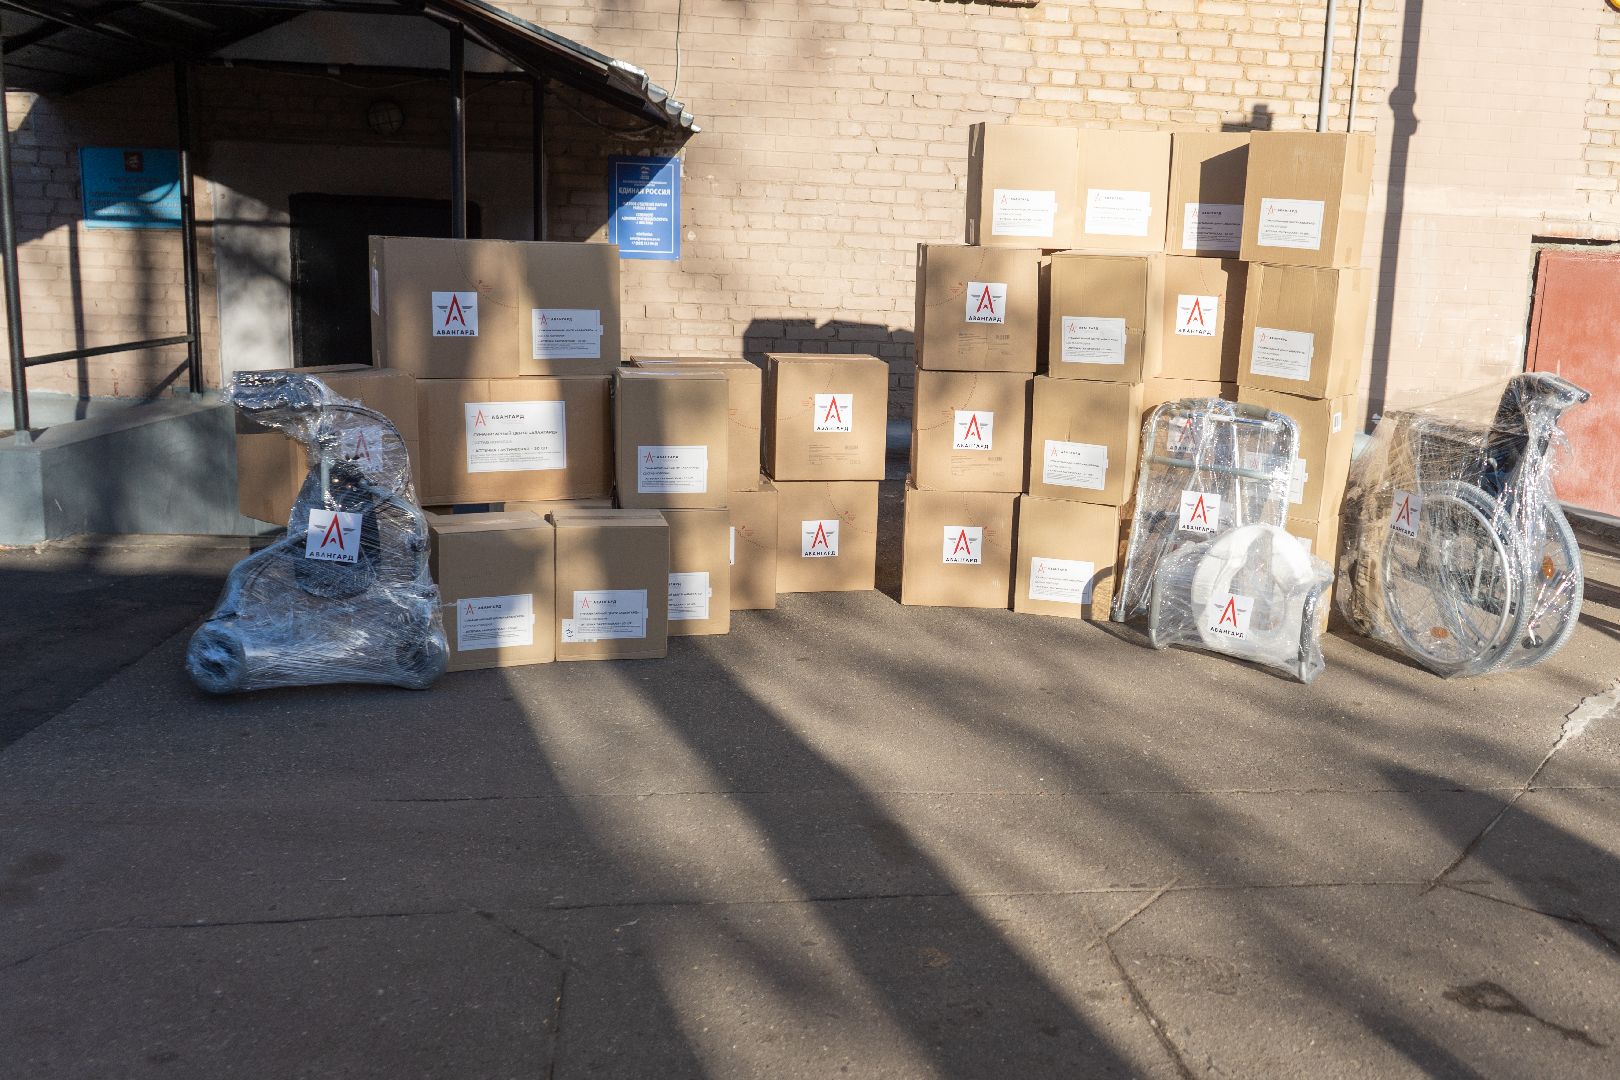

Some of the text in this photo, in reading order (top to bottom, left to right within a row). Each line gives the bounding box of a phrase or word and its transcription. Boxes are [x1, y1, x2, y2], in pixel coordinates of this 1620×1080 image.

[1181, 524, 1215, 533] АВАНГАРД
[309, 551, 354, 561] АВАНГАРД
[1210, 626, 1244, 638] АВАНГАРД
